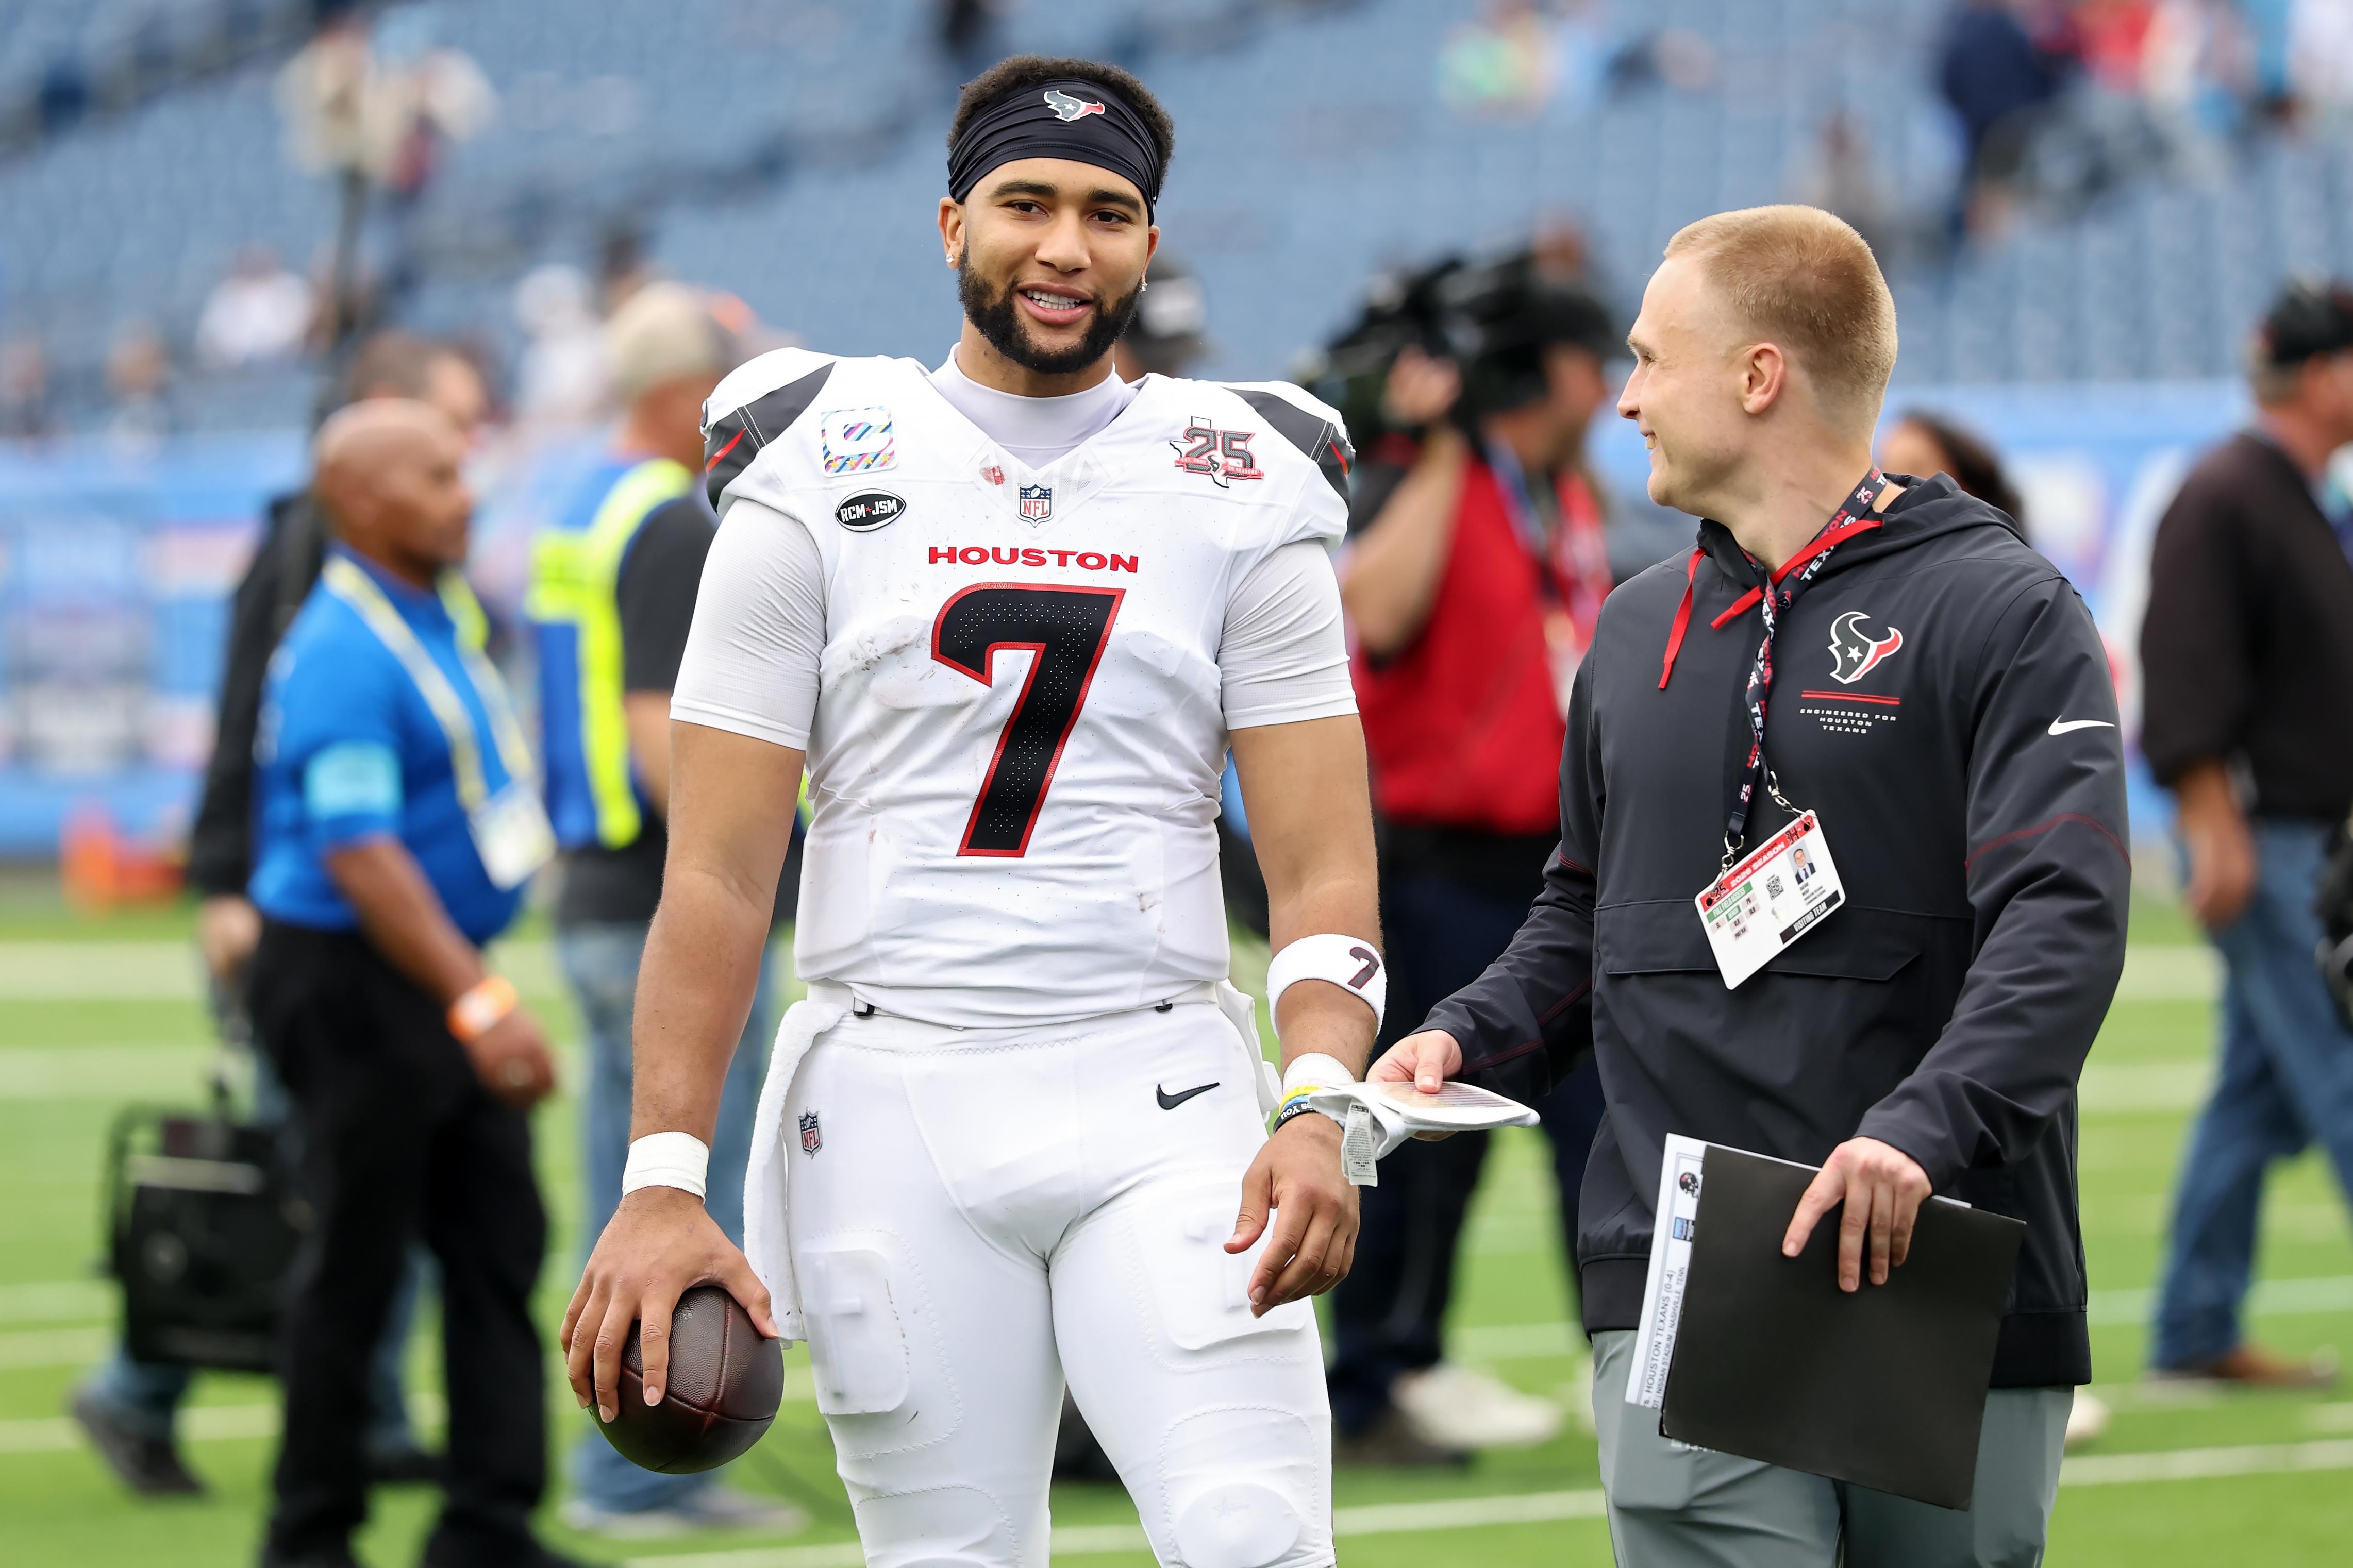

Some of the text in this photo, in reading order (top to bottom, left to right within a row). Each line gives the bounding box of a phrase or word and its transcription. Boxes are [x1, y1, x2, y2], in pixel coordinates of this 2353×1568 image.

[825, 410, 891, 457] C
[1183, 426, 1256, 478] 25
[1022, 500, 1048, 517] NFL
[1856, 486, 1874, 503] 25
[929, 546, 1139, 574] HOUSTON
[931, 582, 1127, 858] 7
[1800, 709, 1868, 719] ENGINEERED
[1820, 717, 1872, 727] HOUSTON
[1823, 724, 1867, 734] TEXANS
[1752, 842, 1785, 870] SEASON
[1712, 886, 1746, 918] FULL FIELD ACCESS
[1793, 901, 1827, 932] VISITING TEAM
[1347, 947, 1380, 990] 7
[1280, 1105, 1300, 1120] You
[803, 1129, 819, 1149] NFL
[1645, 1340, 1662, 1393] HOUSTON
[1656, 1295, 1670, 1337] TEXANS
[1665, 1269, 1676, 1293] (0-4)
[1656, 1367, 1666, 1394] NISSAN
[1662, 1334, 1674, 1367] STADIUM
